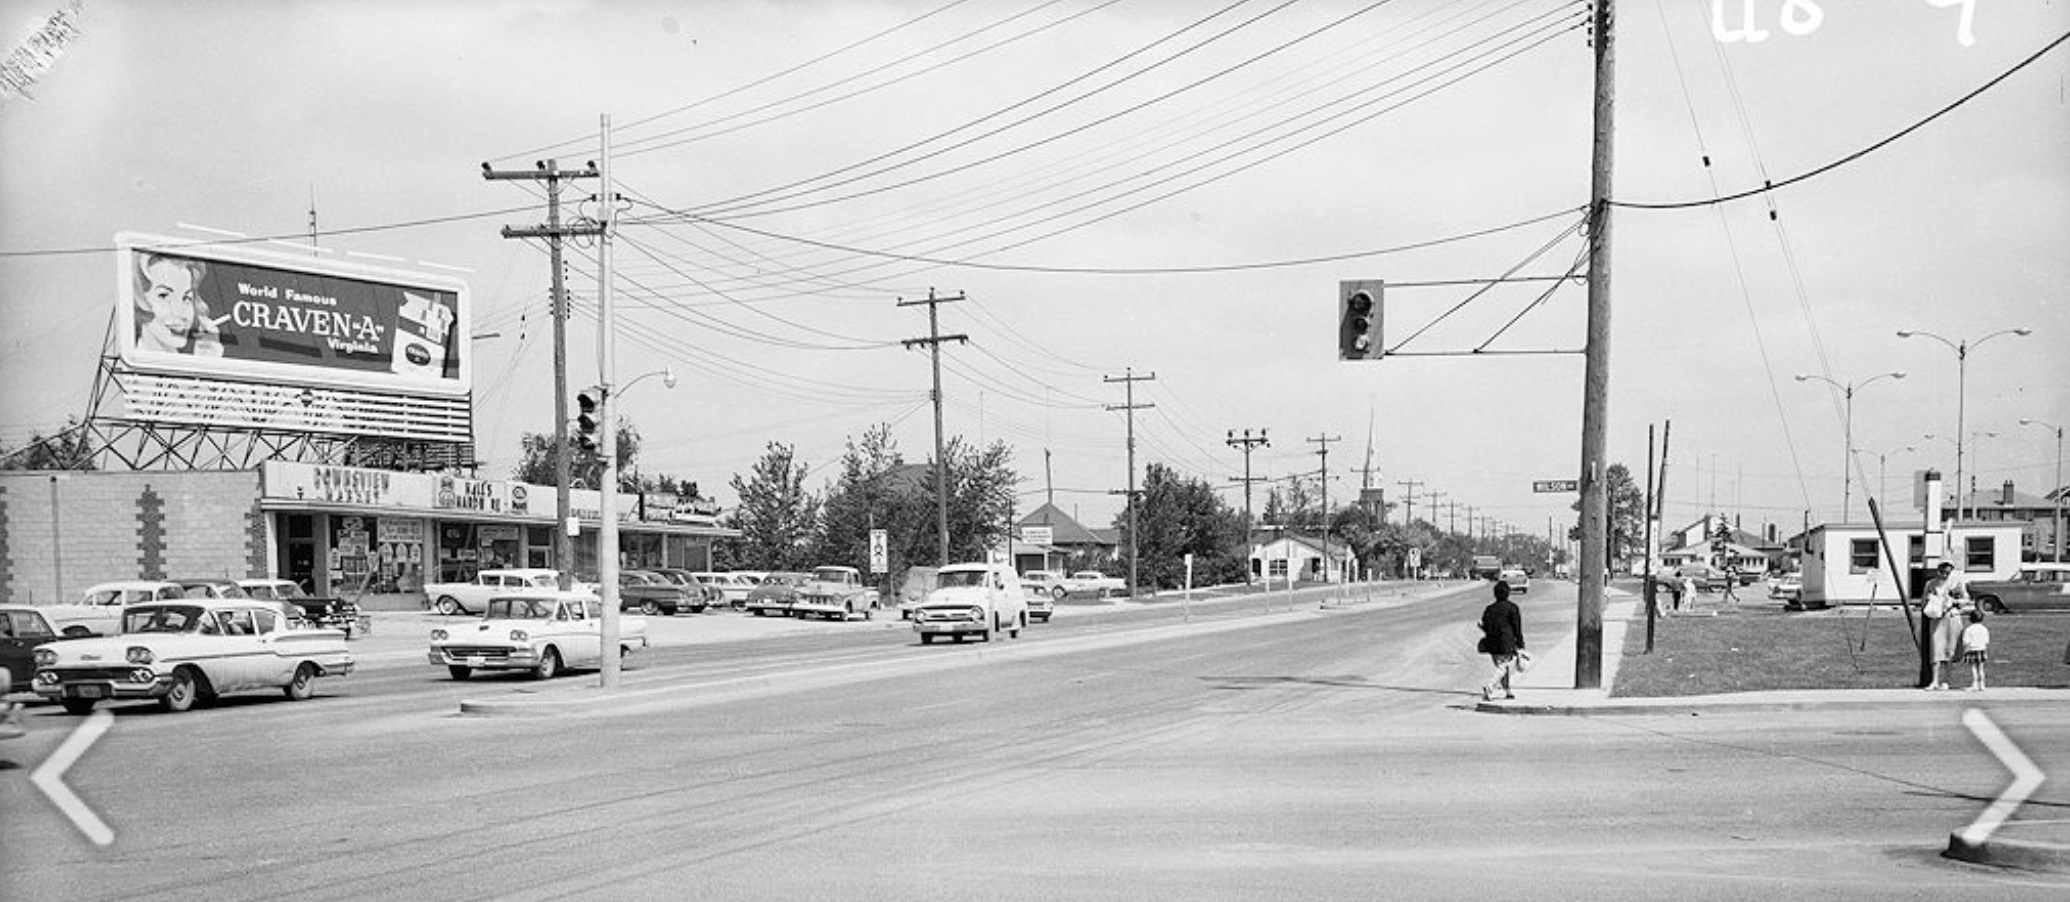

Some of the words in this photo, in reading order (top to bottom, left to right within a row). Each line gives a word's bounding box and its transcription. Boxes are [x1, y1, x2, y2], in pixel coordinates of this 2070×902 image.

[238, 282, 277, 298] World
[285, 289, 337, 306] Famous
[327, 337, 378, 354] Virginia
